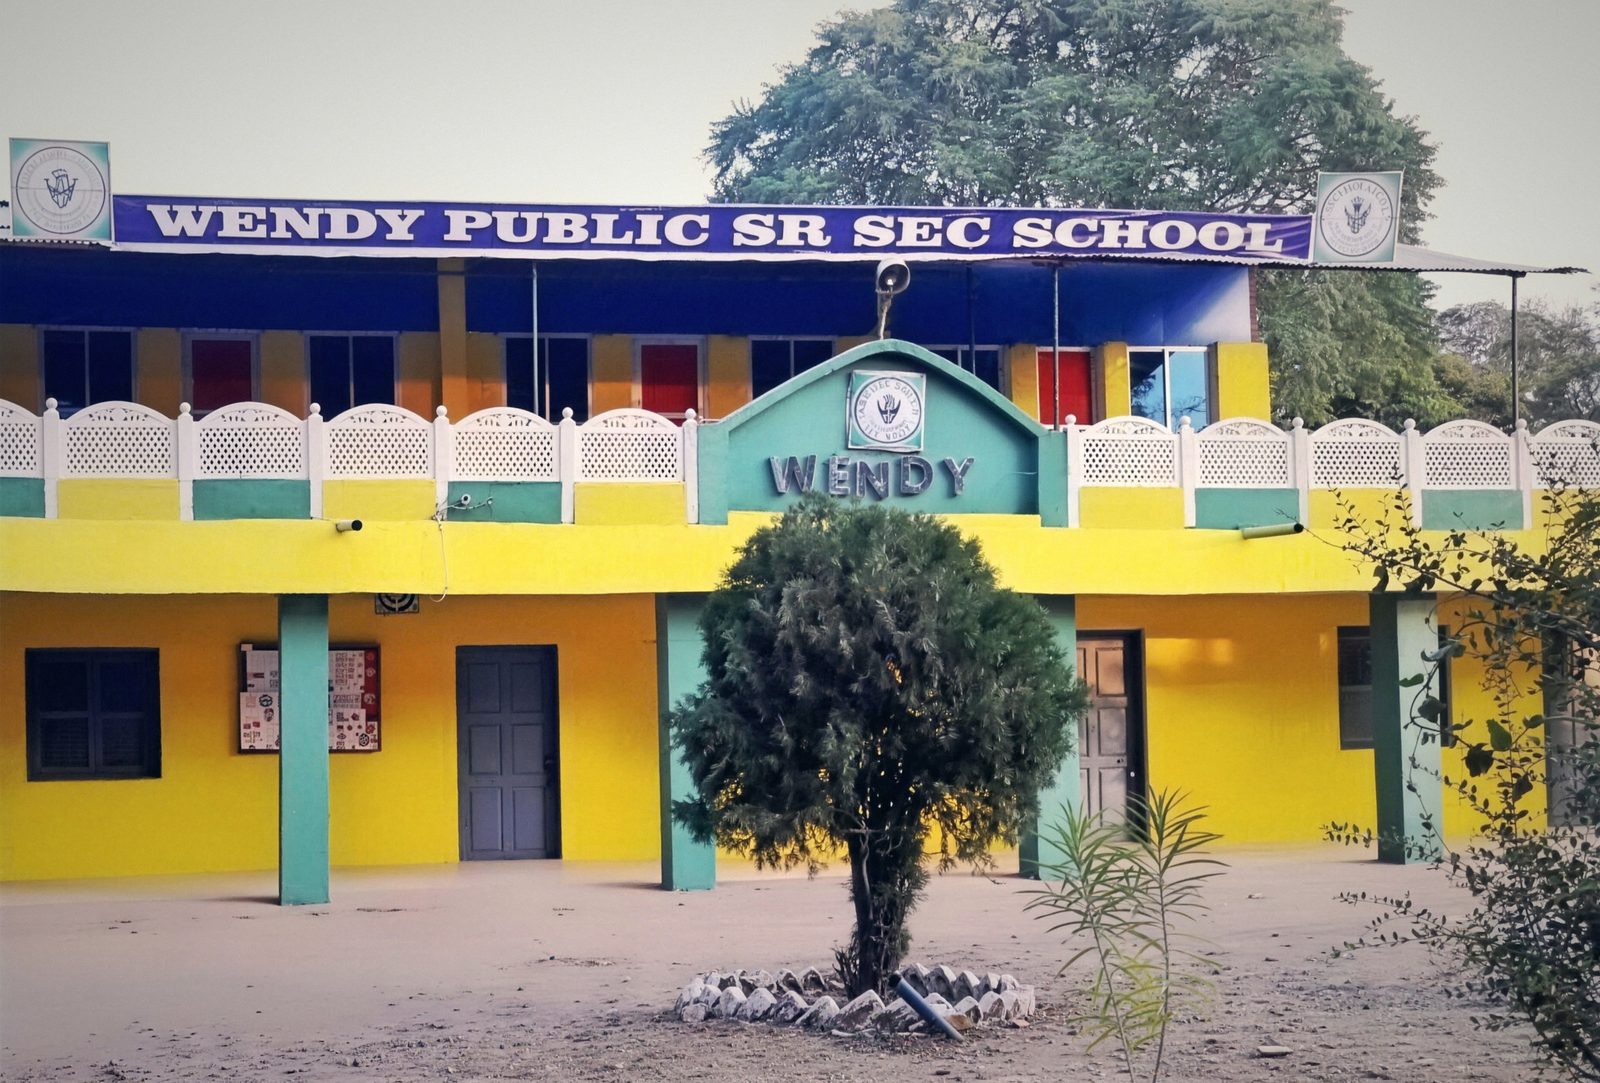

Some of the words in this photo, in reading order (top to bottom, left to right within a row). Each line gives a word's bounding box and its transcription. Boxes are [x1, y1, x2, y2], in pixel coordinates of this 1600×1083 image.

[145, 203, 425, 242] WENDY
[443, 209, 710, 247] PUBLIC
[732, 213, 832, 247] SR
[853, 215, 991, 250] SEC
[1012, 216, 1283, 252] SCHOOL
[769, 454, 975, 500] WENDY
